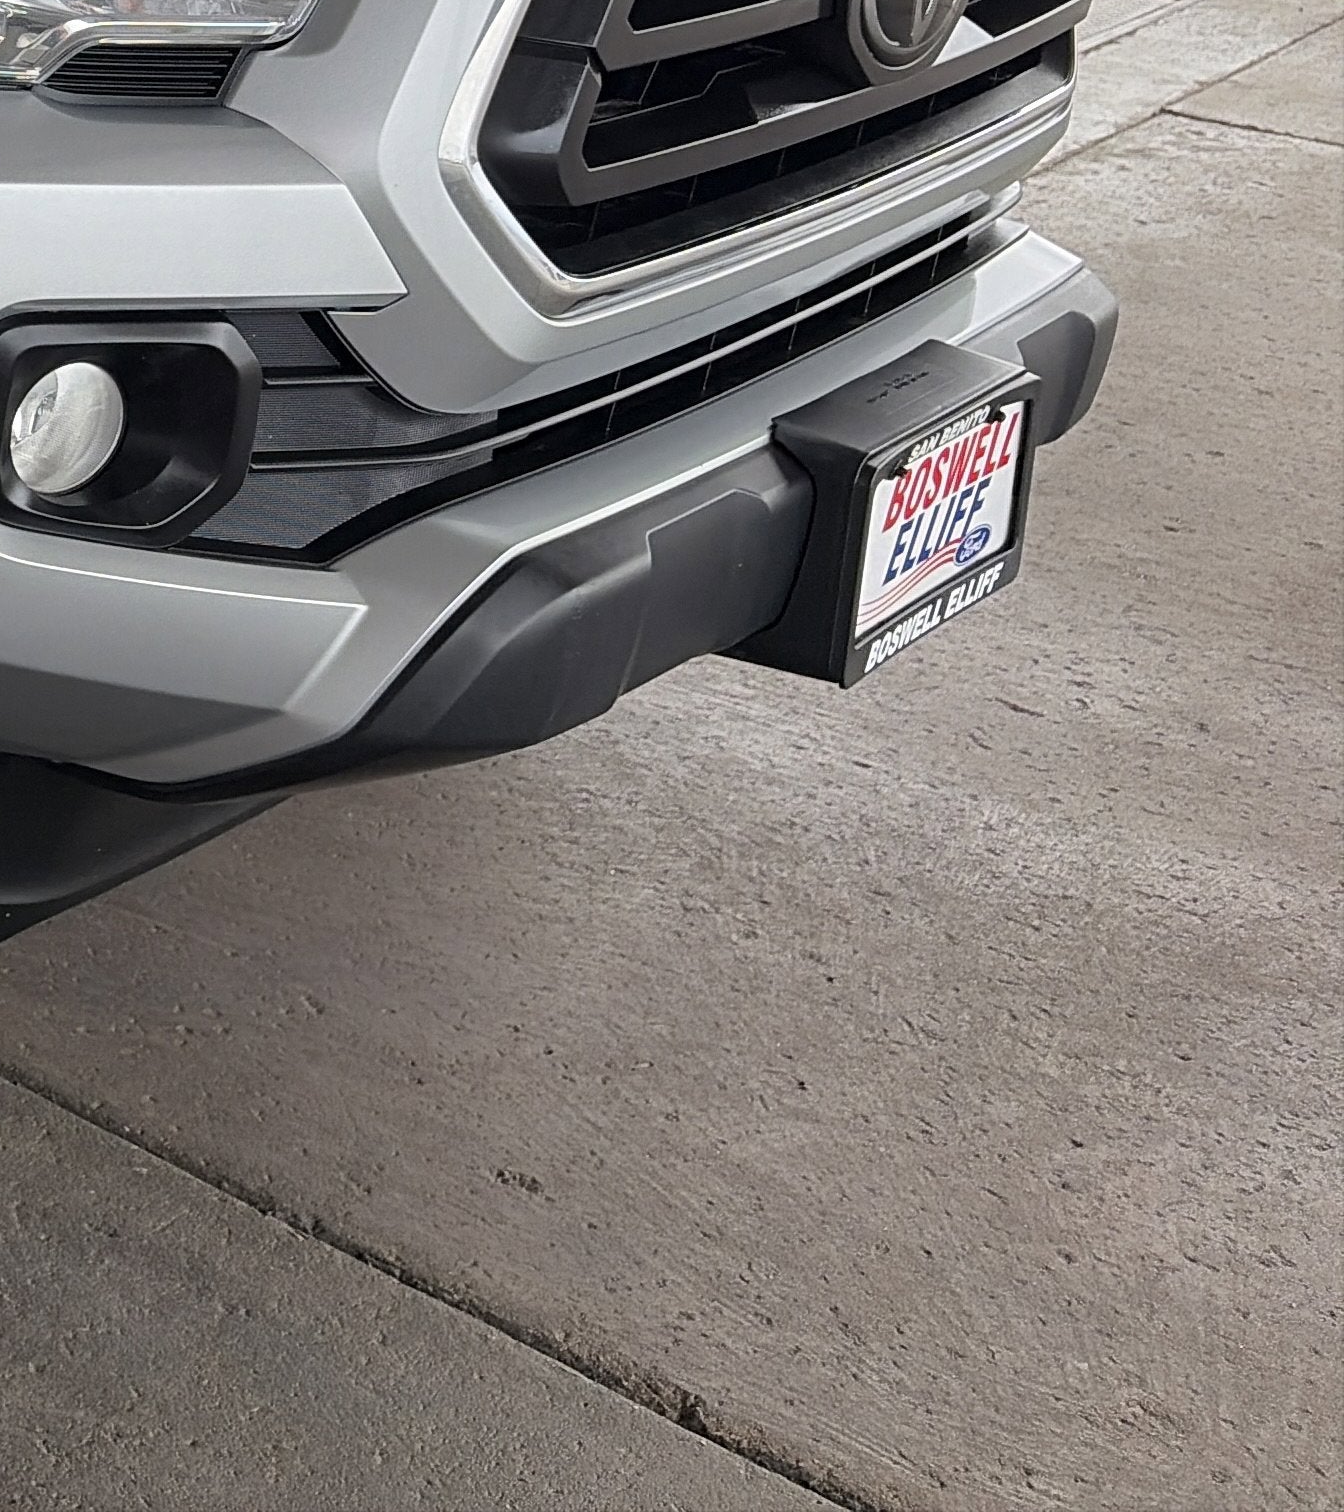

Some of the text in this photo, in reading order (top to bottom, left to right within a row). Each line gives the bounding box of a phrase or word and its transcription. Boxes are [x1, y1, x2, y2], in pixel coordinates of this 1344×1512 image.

[881, 412, 1020, 533] BOSWELL
[908, 405, 991, 463] SAN BENITO
[881, 475, 993, 586] ELLIFF
[864, 561, 1005, 673] BOSWELL ELLIFF
